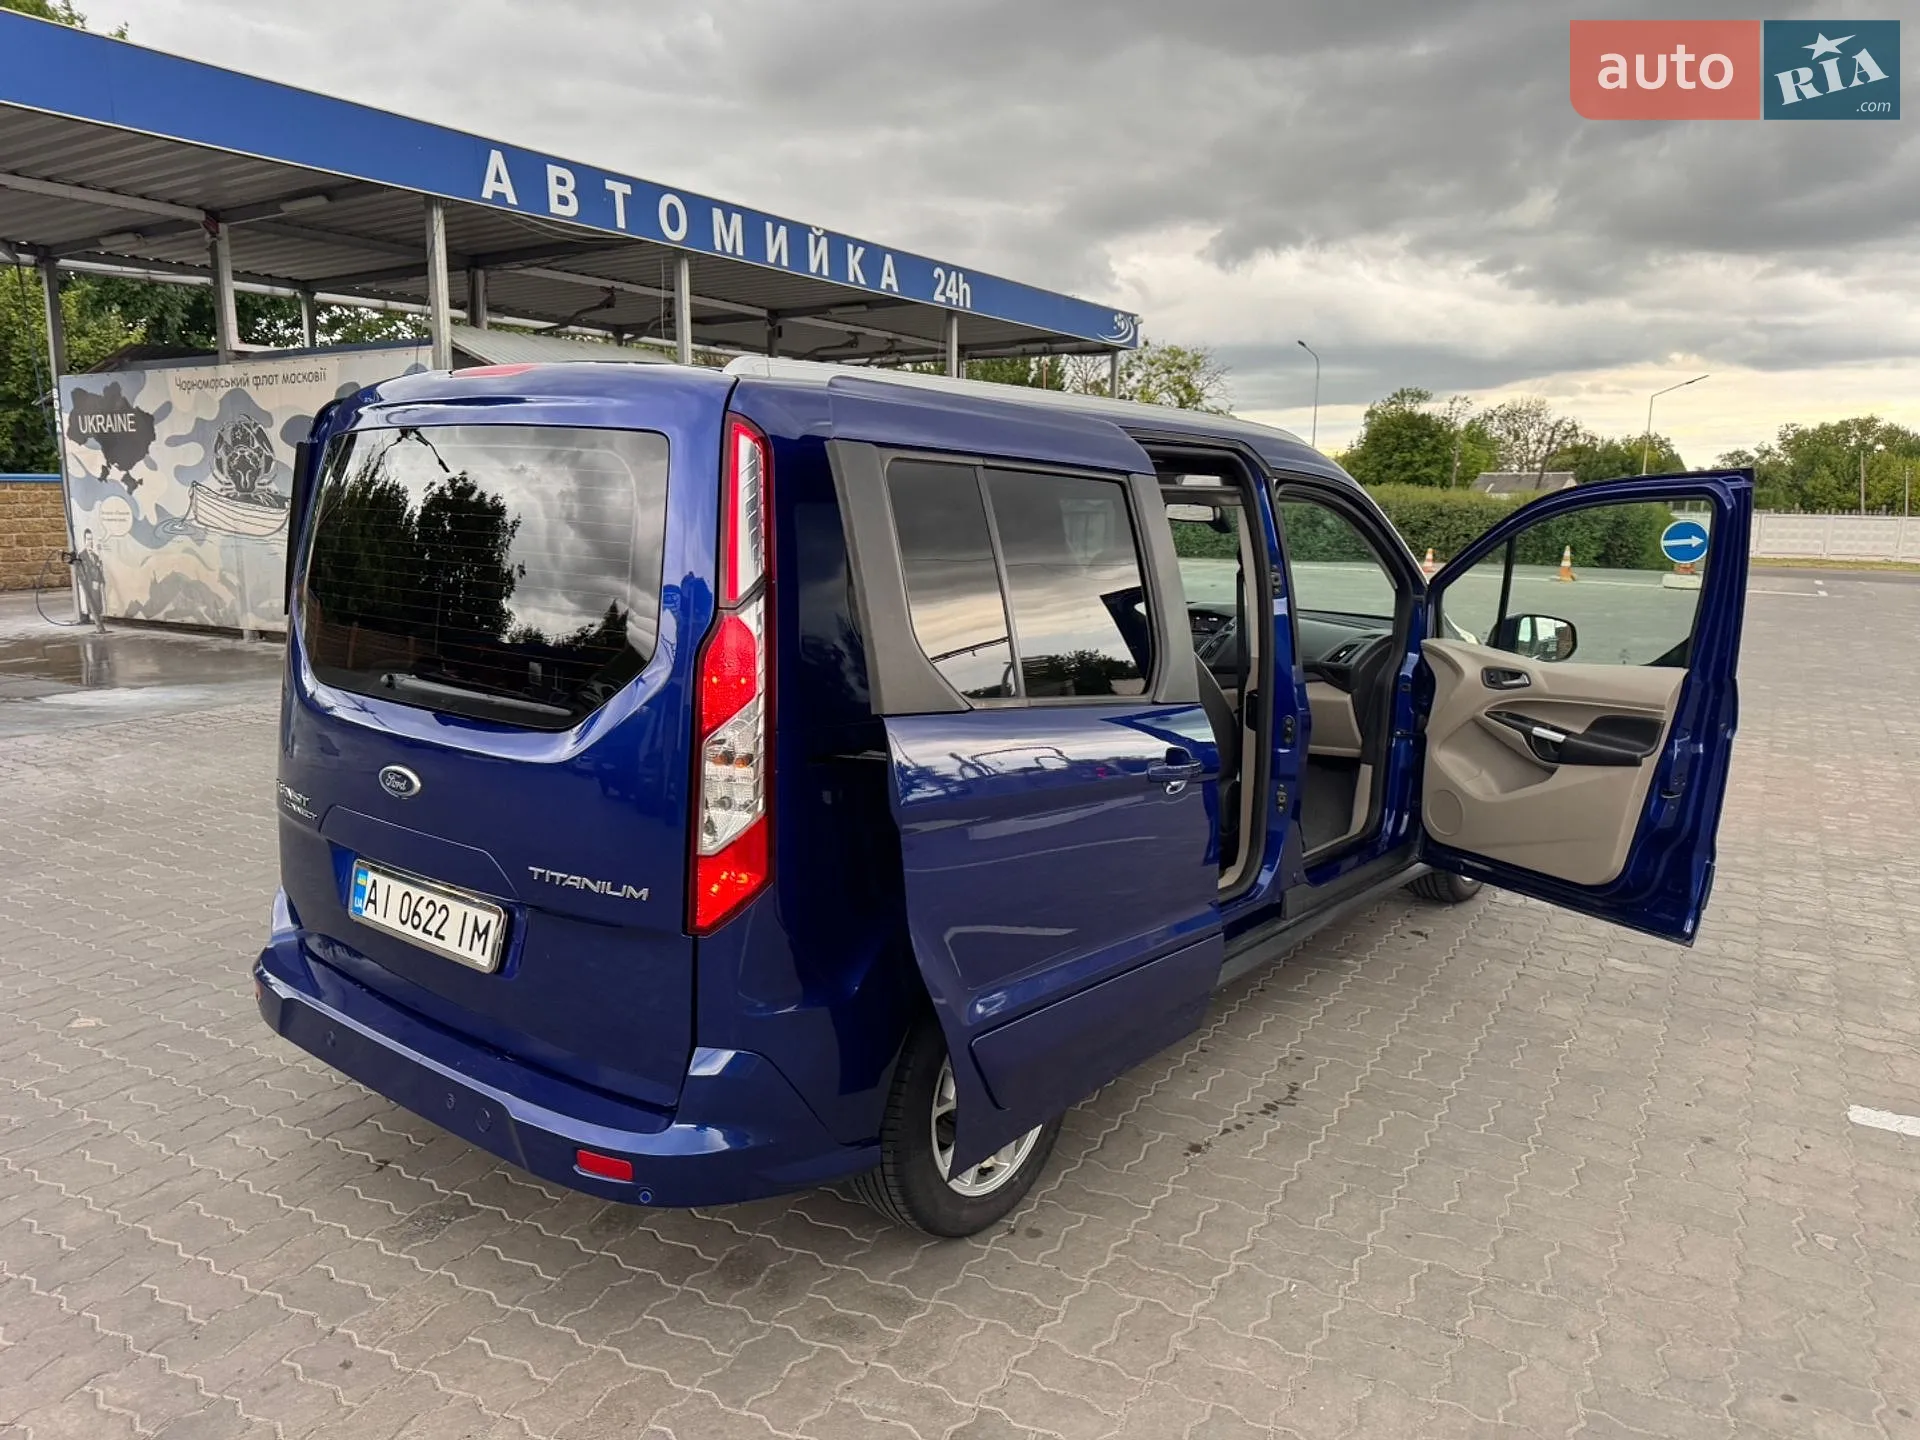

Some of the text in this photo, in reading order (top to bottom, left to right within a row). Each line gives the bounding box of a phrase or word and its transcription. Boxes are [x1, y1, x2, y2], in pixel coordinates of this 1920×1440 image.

[481, 149, 971, 308] АВТОМИЙКА 24h
[252, 374, 278, 391] флот
[79, 413, 136, 433] UKRAINE
[385, 772, 407, 790] Ford
[528, 866, 649, 901] TITANIUM
[365, 879, 492, 956] AI 0622 IM
